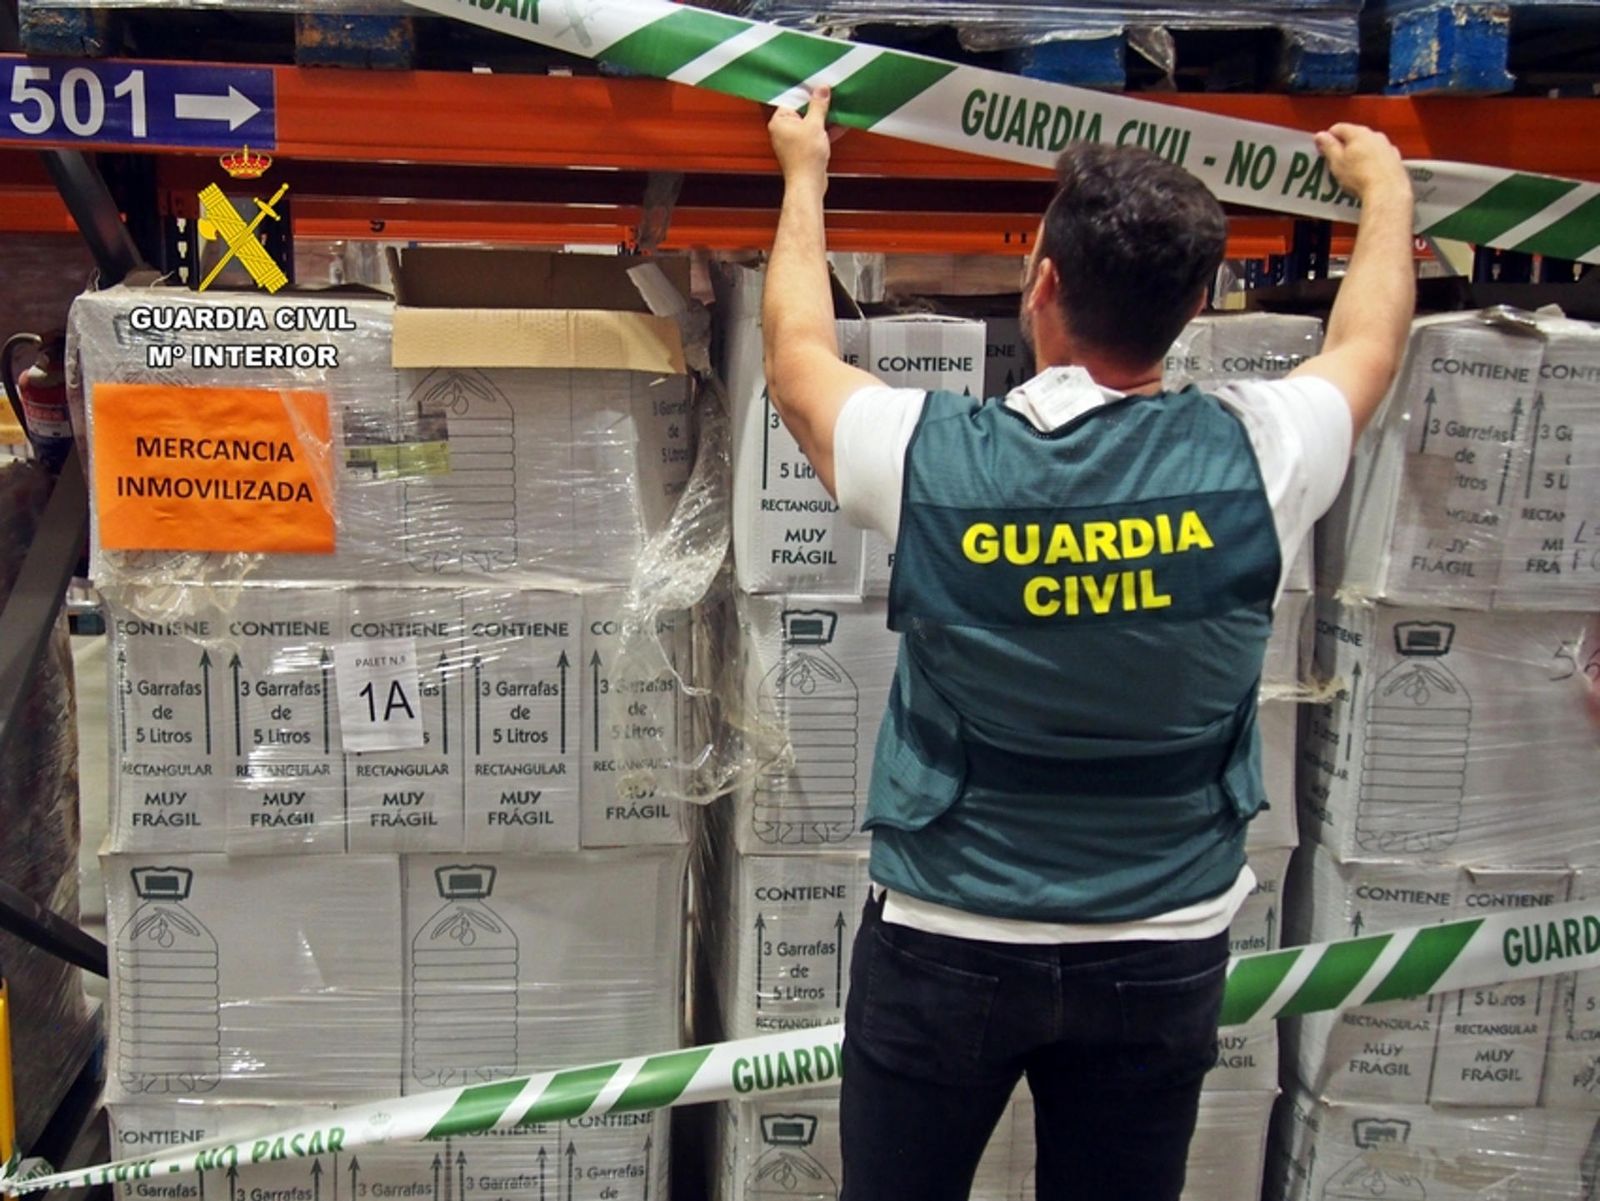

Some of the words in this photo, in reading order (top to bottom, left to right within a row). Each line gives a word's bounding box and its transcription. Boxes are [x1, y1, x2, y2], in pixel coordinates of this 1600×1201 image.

[9, 65, 148, 138] 501
[962, 88, 1102, 153] GUARDIA
[1225, 140, 1277, 191] NO
[877, 356, 973, 372] CONTIENE
[1430, 357, 1530, 384] CONTIENE
[770, 413, 780, 429] 3
[1430, 419, 1440, 435] 3
[1540, 424, 1549, 439] 3
[135, 436, 294, 463] MERCANCIA
[1454, 448, 1476, 465] de
[779, 463, 789, 479] 5
[794, 463, 816, 479] Lit
[117, 475, 313, 503] INMOVILIZADA
[1544, 473, 1555, 489] 5
[761, 499, 840, 513] RECTANGULA
[784, 528, 826, 543] MUY
[961, 510, 1214, 565] GUARDIA
[771, 545, 837, 565] FRÁGIL
[1023, 569, 1172, 617] CIVIL
[229, 621, 331, 637] CONTIENE
[350, 622, 449, 638] CONTIENE
[471, 622, 569, 638] CONTIENE
[355, 657, 386, 668] PALET
[124, 680, 133, 697] 3
[137, 679, 202, 697] Garrafas
[241, 680, 250, 697] 3
[256, 679, 321, 697] Garrafas
[481, 681, 490, 697] 3
[496, 680, 559, 697] Garrafas
[600, 678, 609, 694] 3
[359, 680, 415, 723] 1A
[628, 701, 647, 717] de
[151, 704, 173, 721] de
[270, 704, 292, 721] de
[510, 704, 530, 721] de
[136, 728, 145, 744] 5
[150, 728, 193, 744] Litros
[253, 729, 264, 745] 5
[268, 728, 311, 745] Litros
[493, 728, 502, 744] 5
[507, 728, 549, 744] Litros
[611, 725, 621, 739] 5
[624, 724, 664, 740] Litros
[356, 763, 450, 777] RECTANGULAR
[475, 762, 567, 776] RECTANGULAR
[144, 791, 188, 806] MUY
[262, 791, 306, 806] MUY
[383, 791, 425, 807] MUY
[500, 790, 541, 806] MUY
[132, 808, 202, 827] FRÁGIL
[371, 809, 438, 828] FRÁGIL
[488, 808, 554, 826] FRÁGIL
[605, 802, 671, 820] FRÁGIL
[755, 884, 846, 901] CONTIENE
[1355, 885, 1450, 907] CONTIENE
[1465, 893, 1554, 908] CONTIENE
[763, 941, 772, 956] 3
[777, 940, 836, 957] Garrafas
[1502, 914, 1600, 968] GUARD
[790, 963, 809, 979] de
[773, 985, 782, 1000] 5
[786, 985, 825, 1000] Litros
[1474, 991, 1483, 1006] 5
[1586, 996, 1596, 1011] 5
[1342, 1013, 1430, 1032] RECTANGULAR
[1454, 1023, 1538, 1036] RECTANGULAR
[1363, 1042, 1403, 1057] MUY
[1474, 1048, 1514, 1063] MUY
[732, 1041, 844, 1093] GUARDI
[1461, 1065, 1523, 1082] FRÁGIL
[568, 1111, 655, 1129] CONTIENE
[252, 1127, 345, 1163] PASAR
[574, 1166, 583, 1180] 3
[587, 1164, 645, 1180] Garrafas
[124, 1182, 133, 1197] 3
[137, 1181, 198, 1198] Garrafas
[358, 1183, 367, 1197] 3
[371, 1182, 432, 1197] Garrafas
[466, 1177, 475, 1191] 3
[479, 1174, 537, 1192] Garrafas
[237, 1189, 246, 1201] 3
[250, 1187, 313, 1201] Garrafas
[600, 1186, 618, 1200] de
